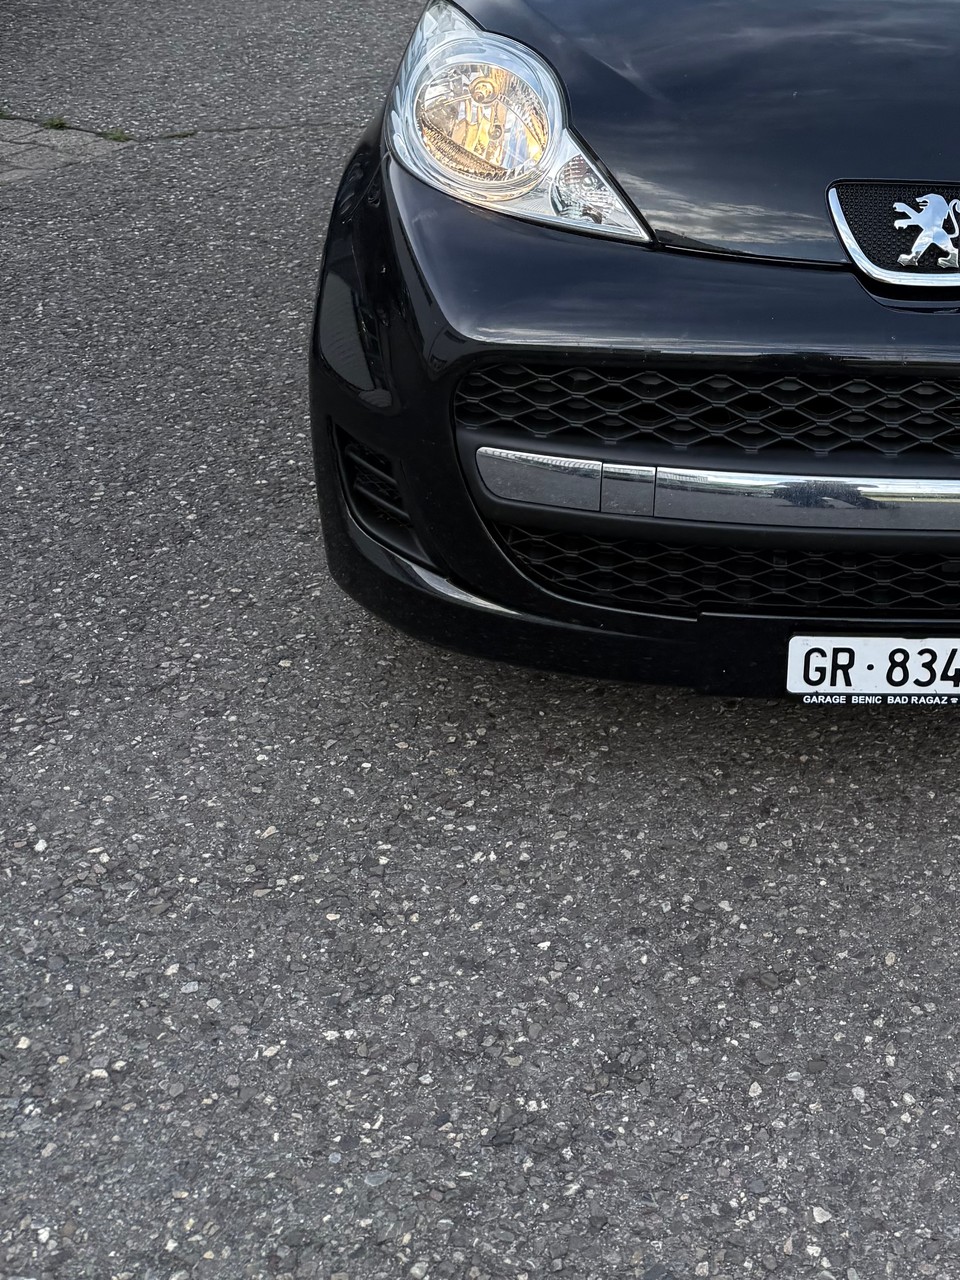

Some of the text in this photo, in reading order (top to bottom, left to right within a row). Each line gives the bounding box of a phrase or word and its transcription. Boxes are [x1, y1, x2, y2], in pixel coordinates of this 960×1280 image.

[803, 695, 847, 704] GARAGE
[851, 695, 882, 704] BENIC
[887, 695, 909, 704] BAD
[911, 696, 948, 704] RAGAZ
